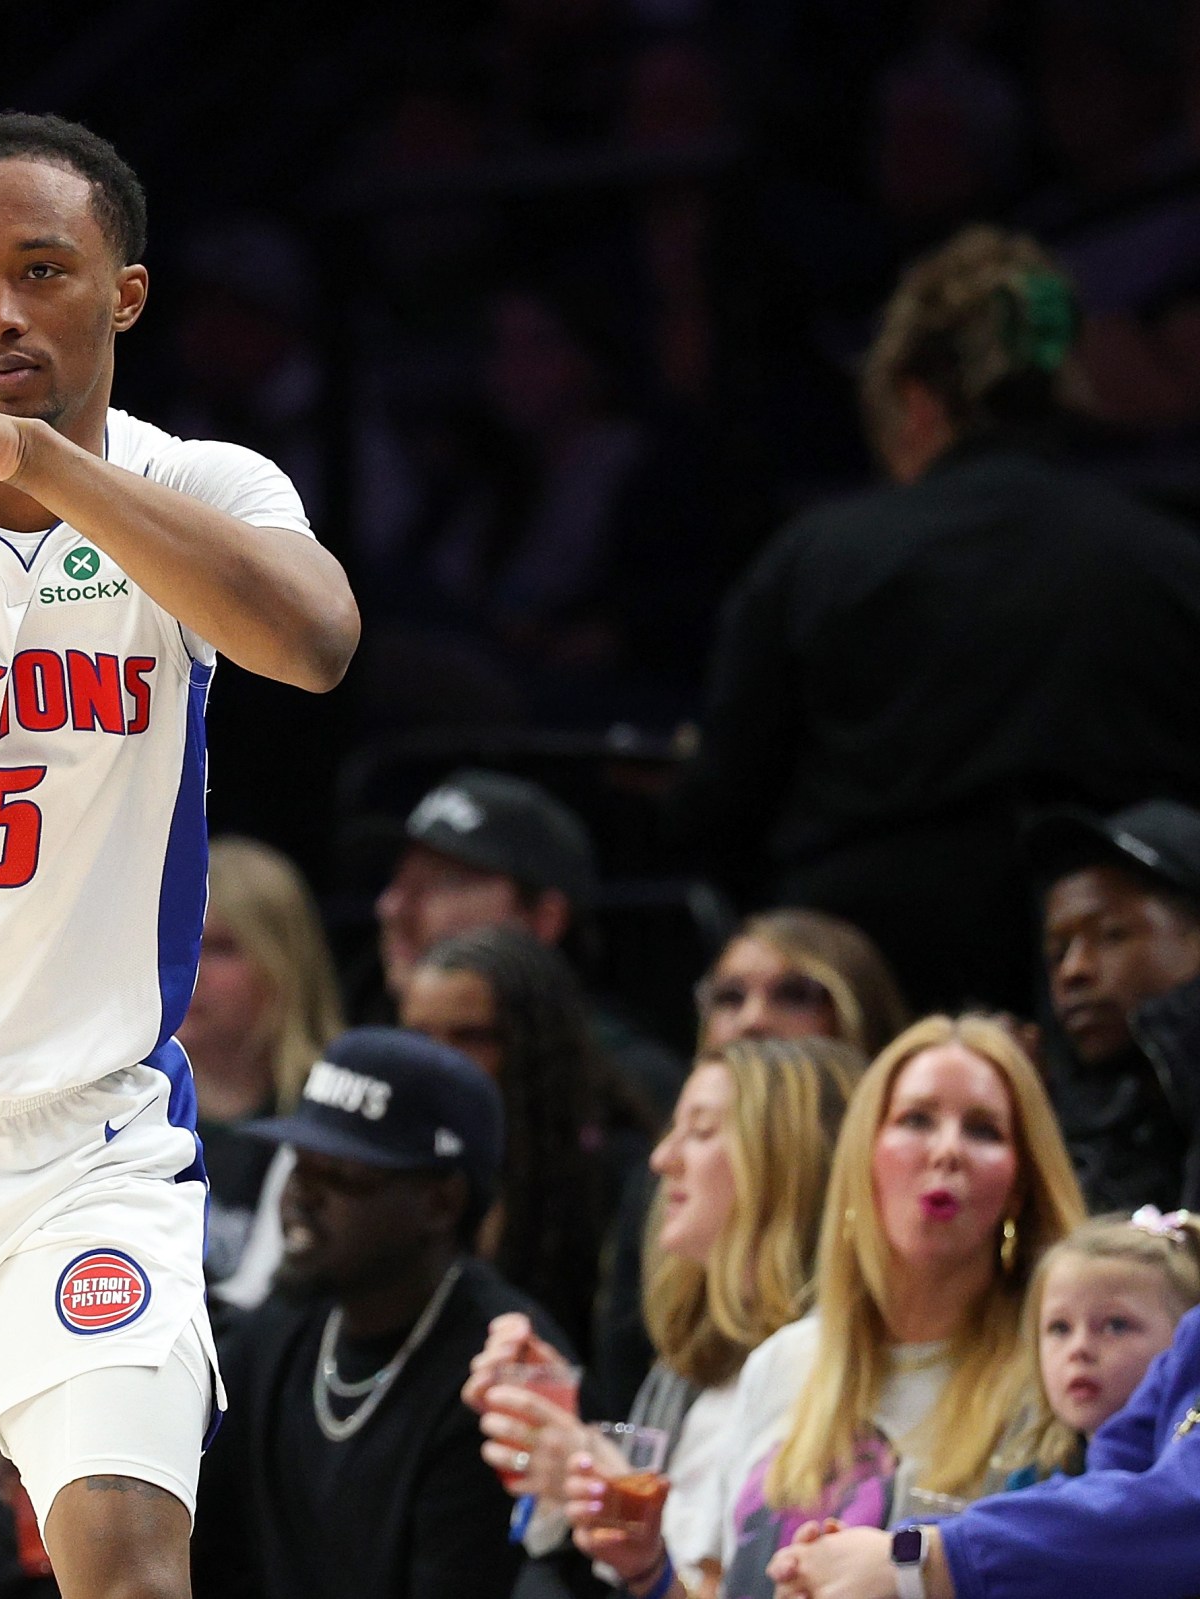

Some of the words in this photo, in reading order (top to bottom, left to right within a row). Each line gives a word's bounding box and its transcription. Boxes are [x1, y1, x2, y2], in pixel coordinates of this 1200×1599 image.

[40, 579, 129, 604] StockX
[72, 1277, 132, 1294] DETROIT
[71, 1290, 132, 1309] PISTONS
